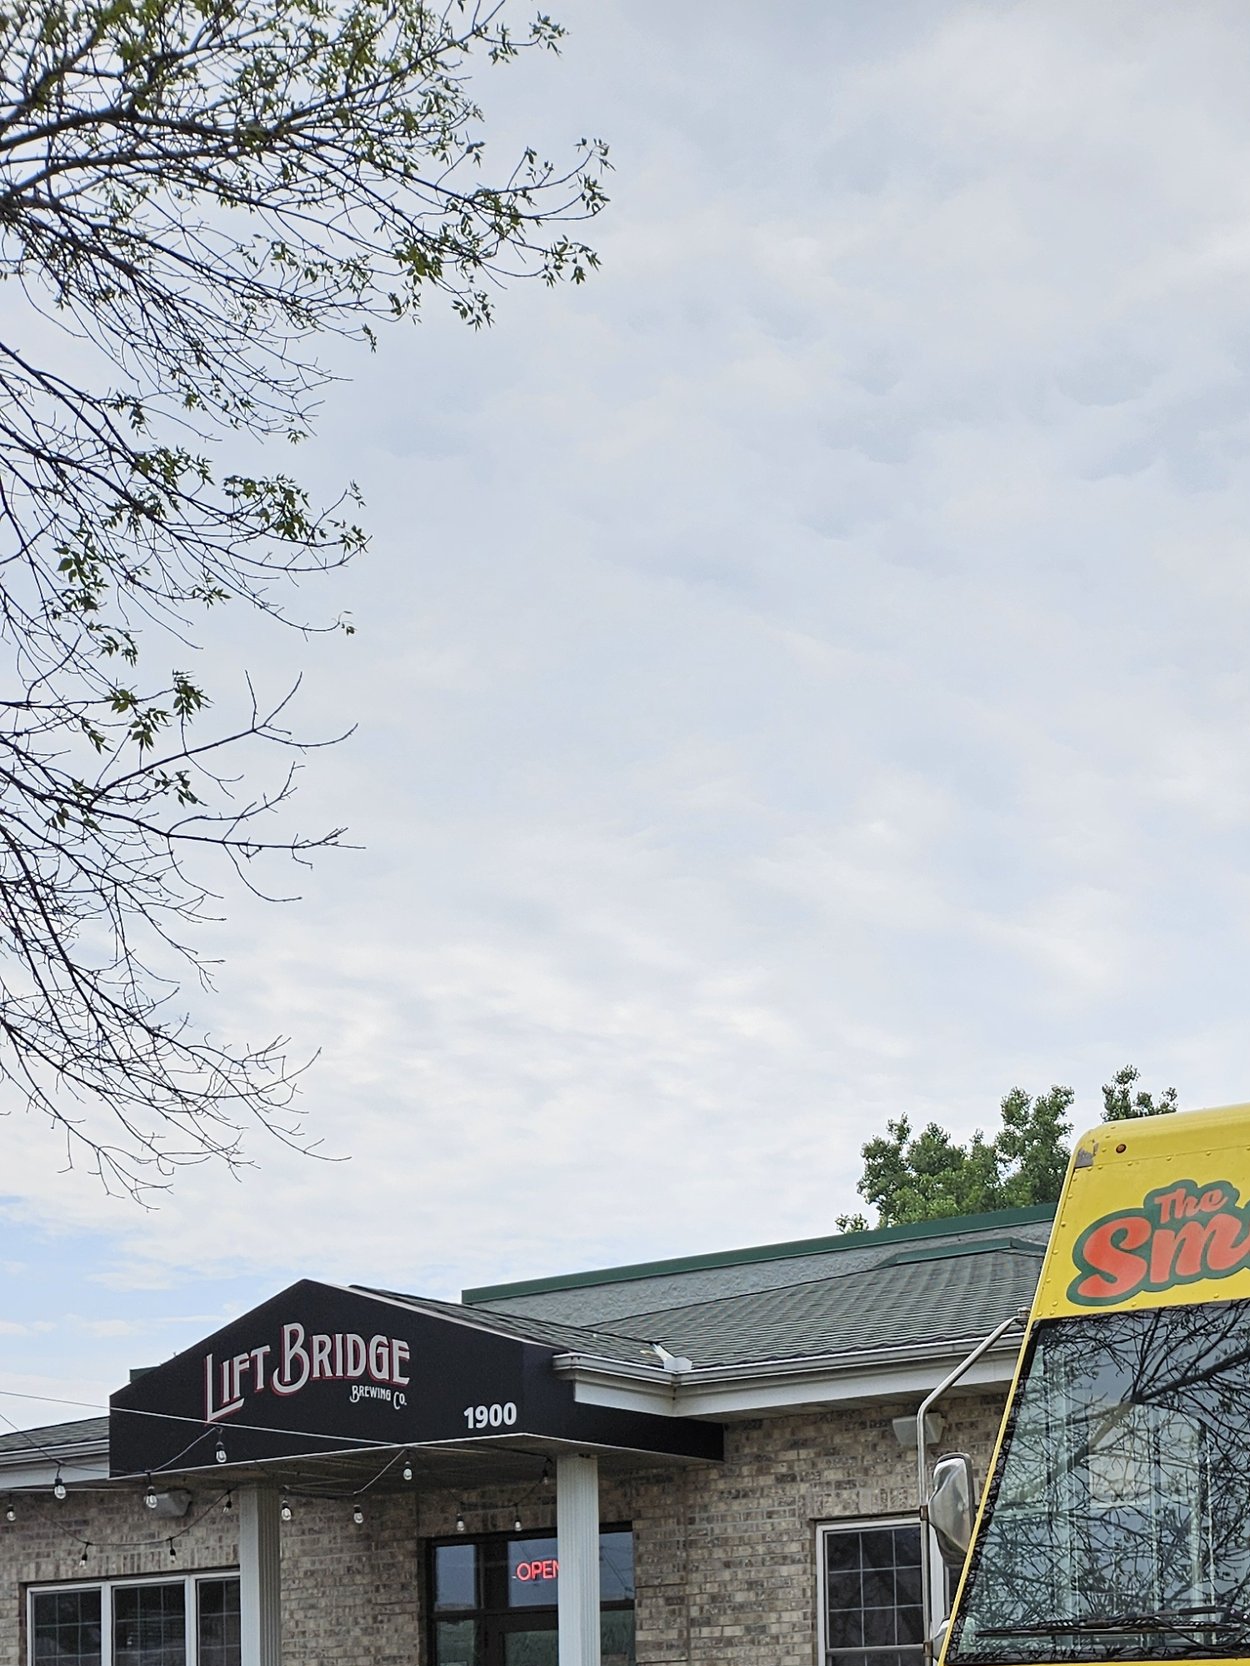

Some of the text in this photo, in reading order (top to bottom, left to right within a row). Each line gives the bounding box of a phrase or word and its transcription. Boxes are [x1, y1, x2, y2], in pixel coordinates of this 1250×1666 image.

[1152, 1184, 1231, 1223] The
[204, 1322, 411, 1425] LIFT BRIDGE
[350, 1385, 392, 1404] BREWING
[463, 1402, 518, 1429] 1900
